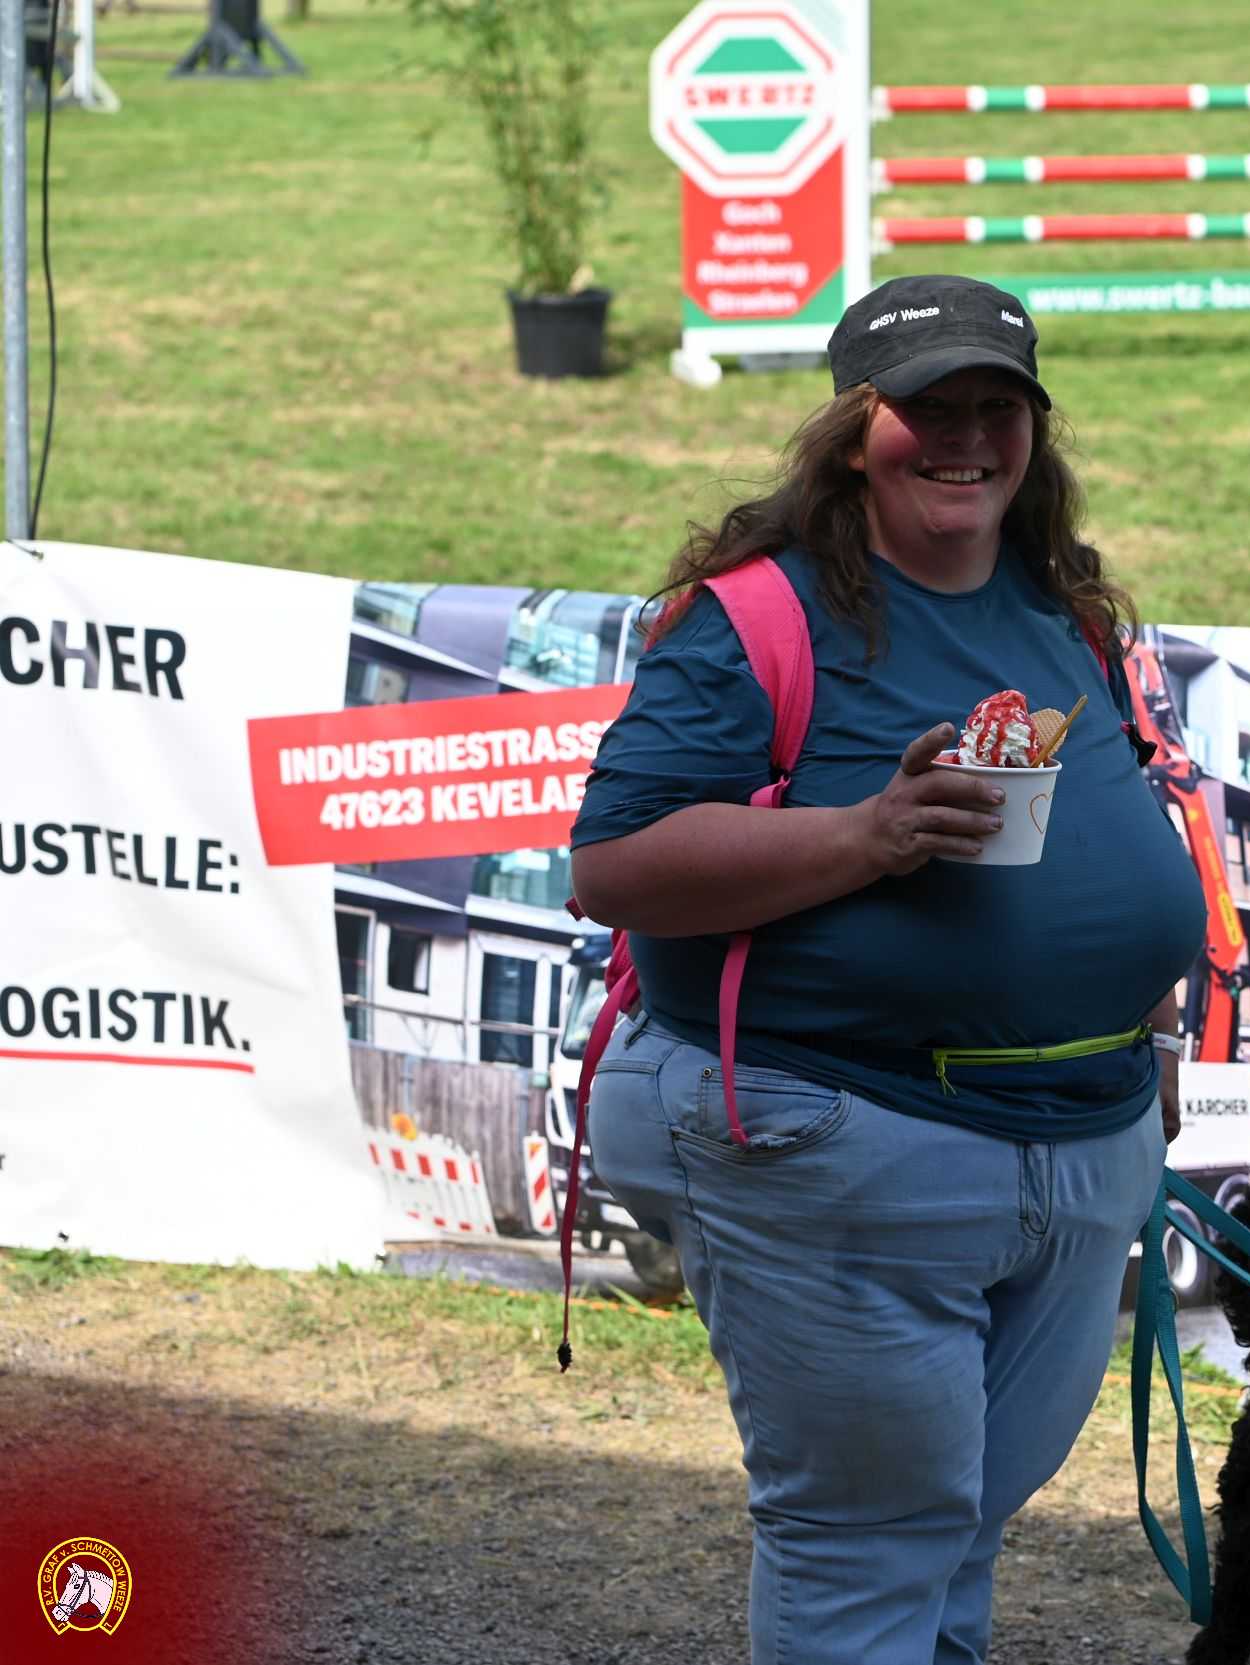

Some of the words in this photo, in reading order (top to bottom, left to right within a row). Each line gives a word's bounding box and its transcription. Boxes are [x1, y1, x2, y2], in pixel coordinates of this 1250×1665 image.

[685, 84, 815, 108] SWERTZ
[900, 306, 940, 322] Weeze
[279, 719, 616, 786] INDUSTRIESTRASS
[320, 786, 426, 831] 47623
[1186, 1098, 1249, 1117] KARCHER
